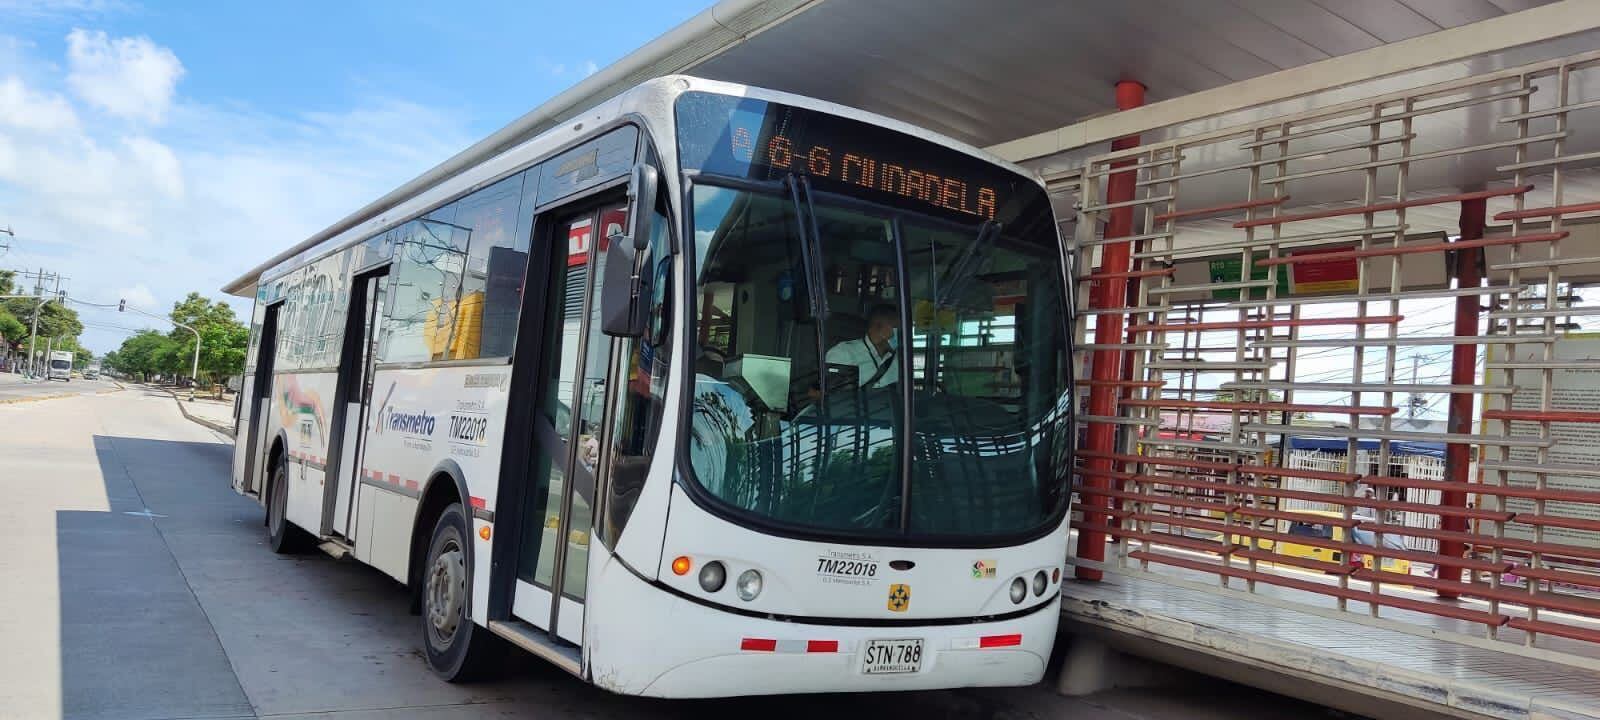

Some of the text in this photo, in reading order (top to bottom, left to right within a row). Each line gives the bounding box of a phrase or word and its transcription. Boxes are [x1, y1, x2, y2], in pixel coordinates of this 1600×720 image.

[732, 127, 753, 161] A
[385, 406, 436, 436] Transmetro
[448, 415, 488, 441] TM22018
[817, 558, 877, 577] TM22018
[866, 645, 921, 665] STN 788
